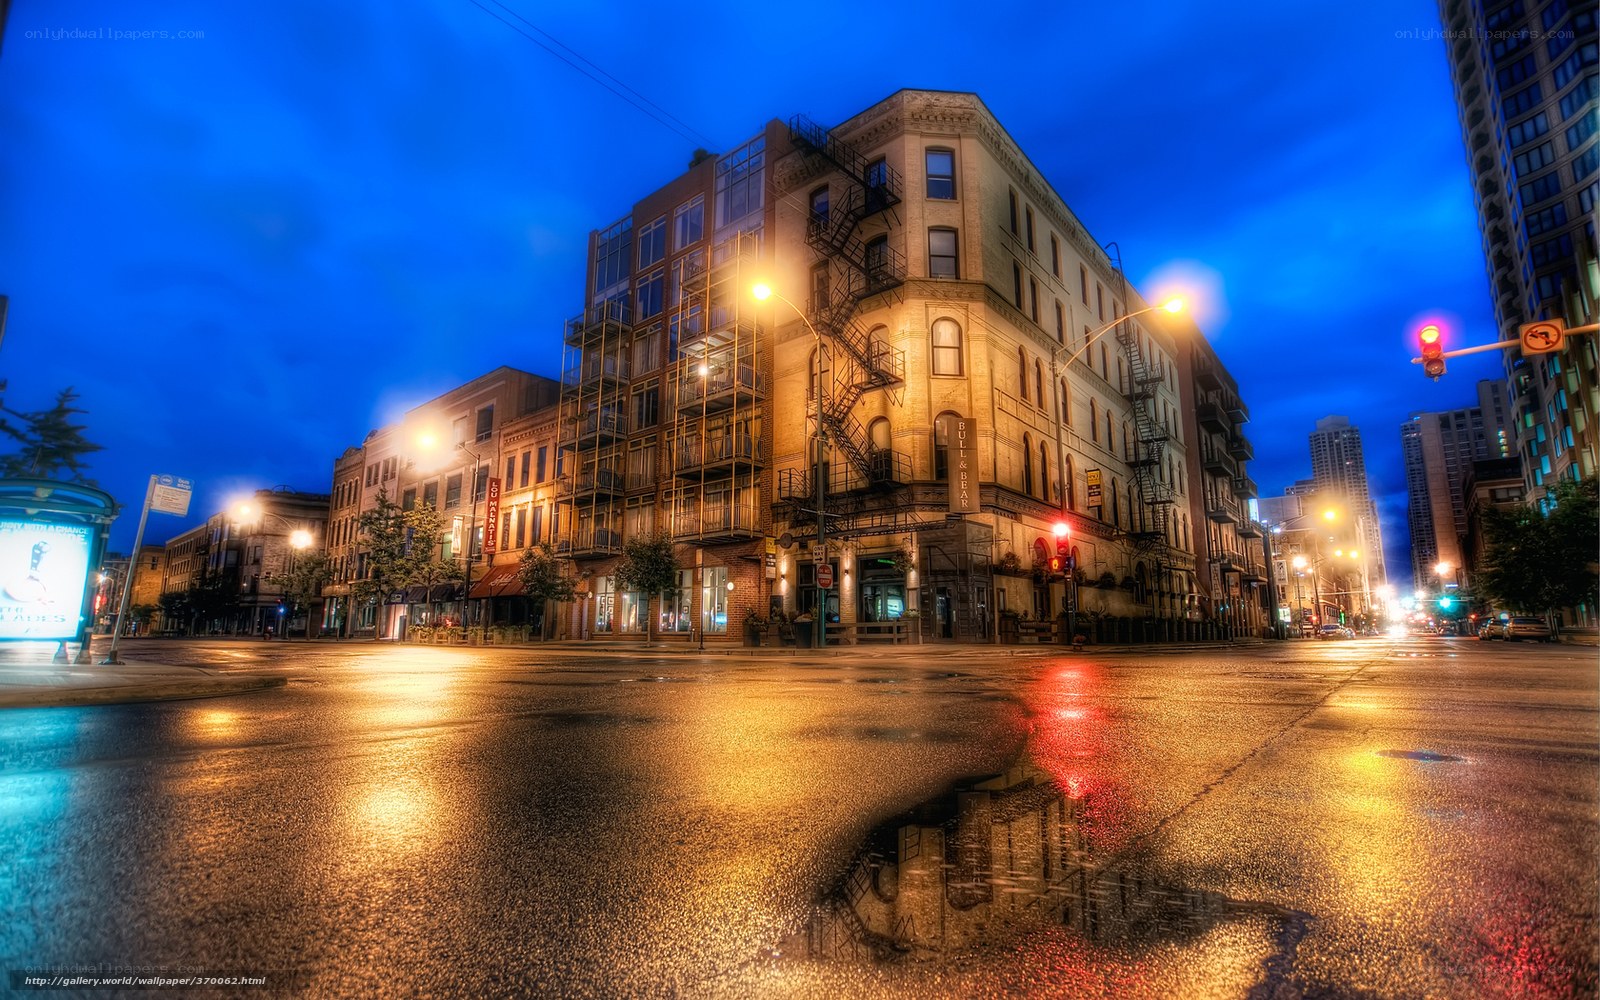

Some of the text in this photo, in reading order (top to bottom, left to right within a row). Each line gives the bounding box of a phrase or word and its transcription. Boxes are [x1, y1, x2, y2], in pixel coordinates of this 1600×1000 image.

[490, 482, 498, 498] LOU
[958, 421, 969, 508] BULL & BEAR
